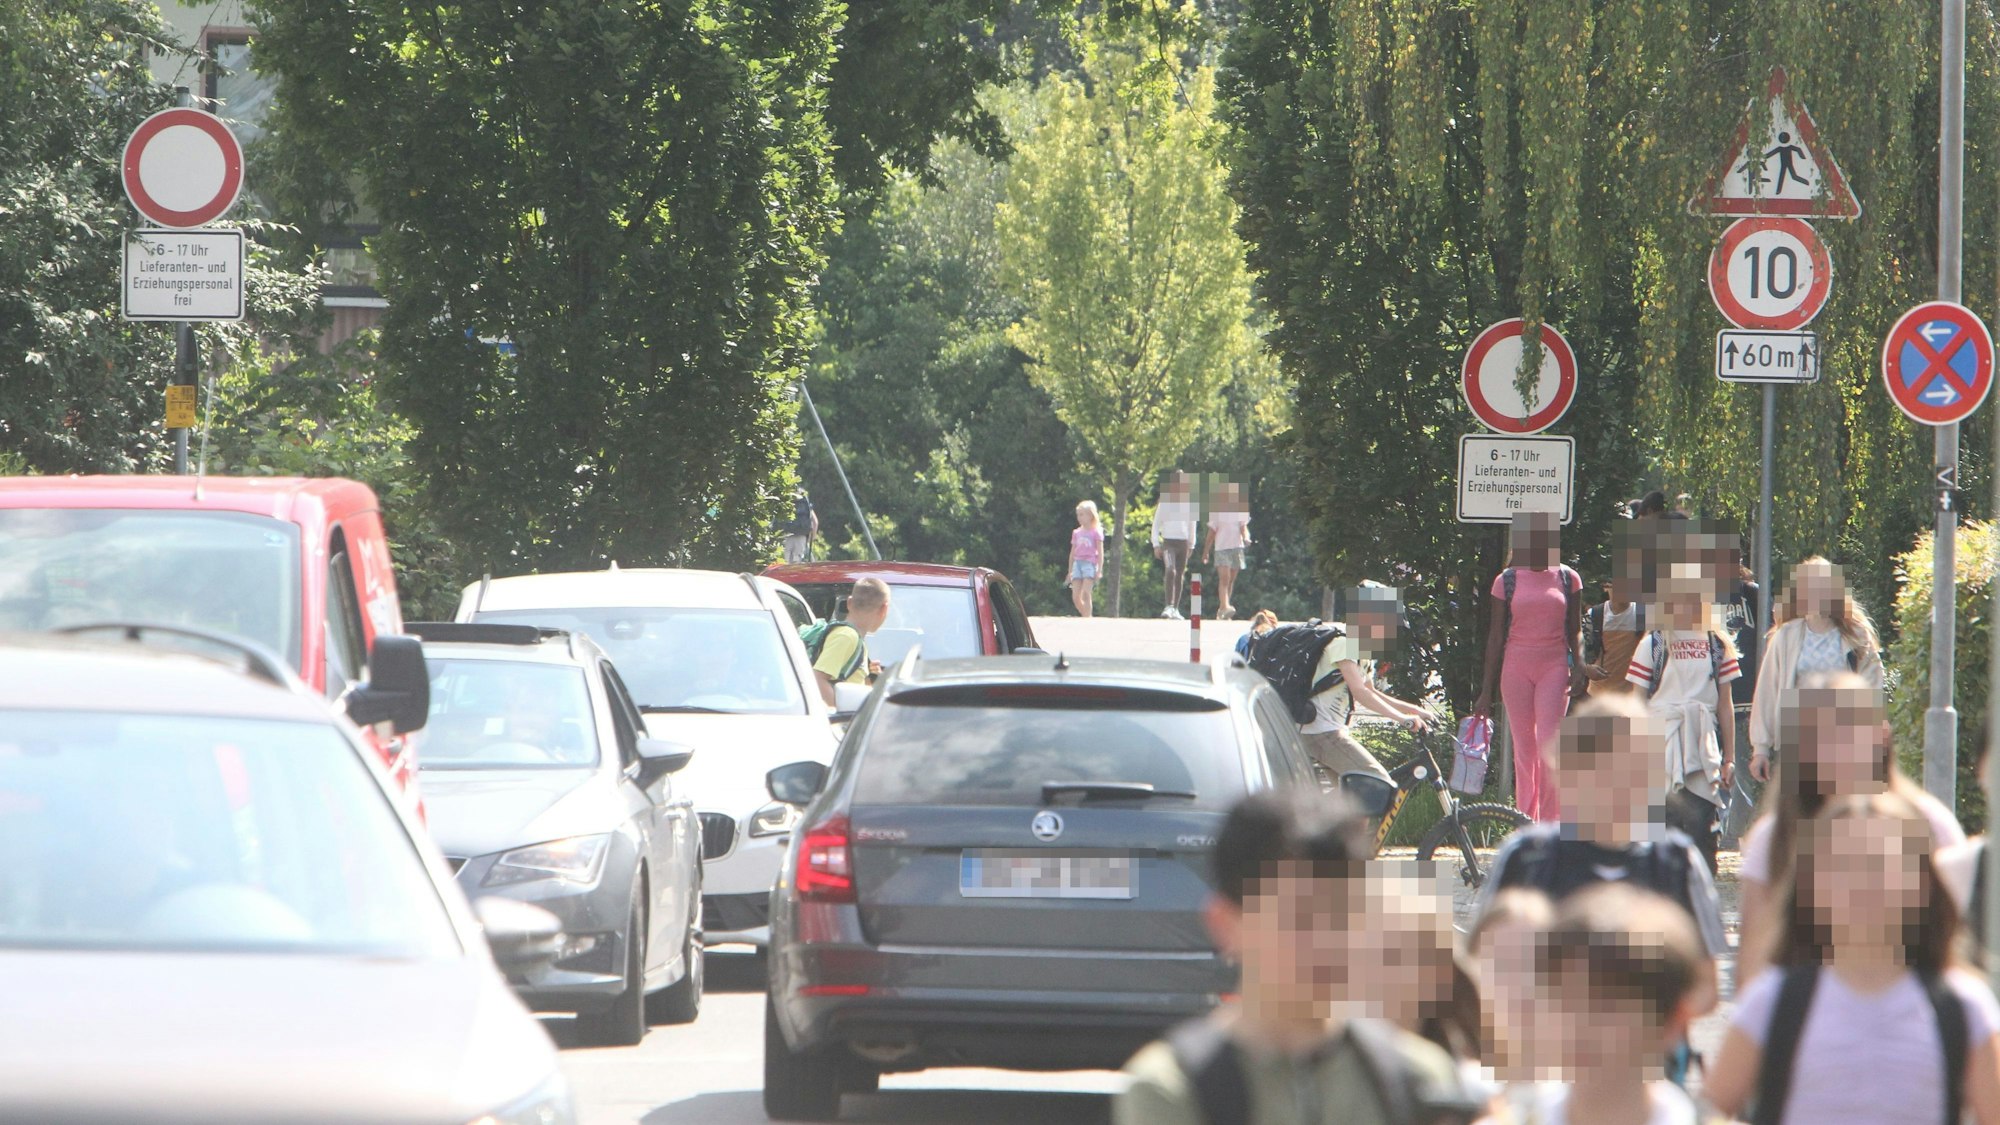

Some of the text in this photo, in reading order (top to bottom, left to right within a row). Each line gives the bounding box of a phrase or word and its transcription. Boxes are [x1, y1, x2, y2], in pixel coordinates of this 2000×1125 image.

[156, 243, 165, 256] 6
[177, 244, 188, 256] 17
[191, 244, 209, 256] Uhr
[140, 260, 226, 273] Lieferanten- und
[1744, 246, 1797, 300] 10
[133, 276, 233, 292] Erziehungspersonal
[174, 294, 192, 306] frei
[1742, 344, 1794, 368] 60 m
[1490, 449, 1499, 461] 6
[1510, 449, 1521, 461] 17
[1523, 450, 1540, 462] Uhr
[1475, 465, 1556, 478] Lieferanten- und
[1468, 480, 1562, 496] Erziehungspersonal
[1505, 497, 1523, 509] frei
[1176, 834, 1218, 846] OCTA
